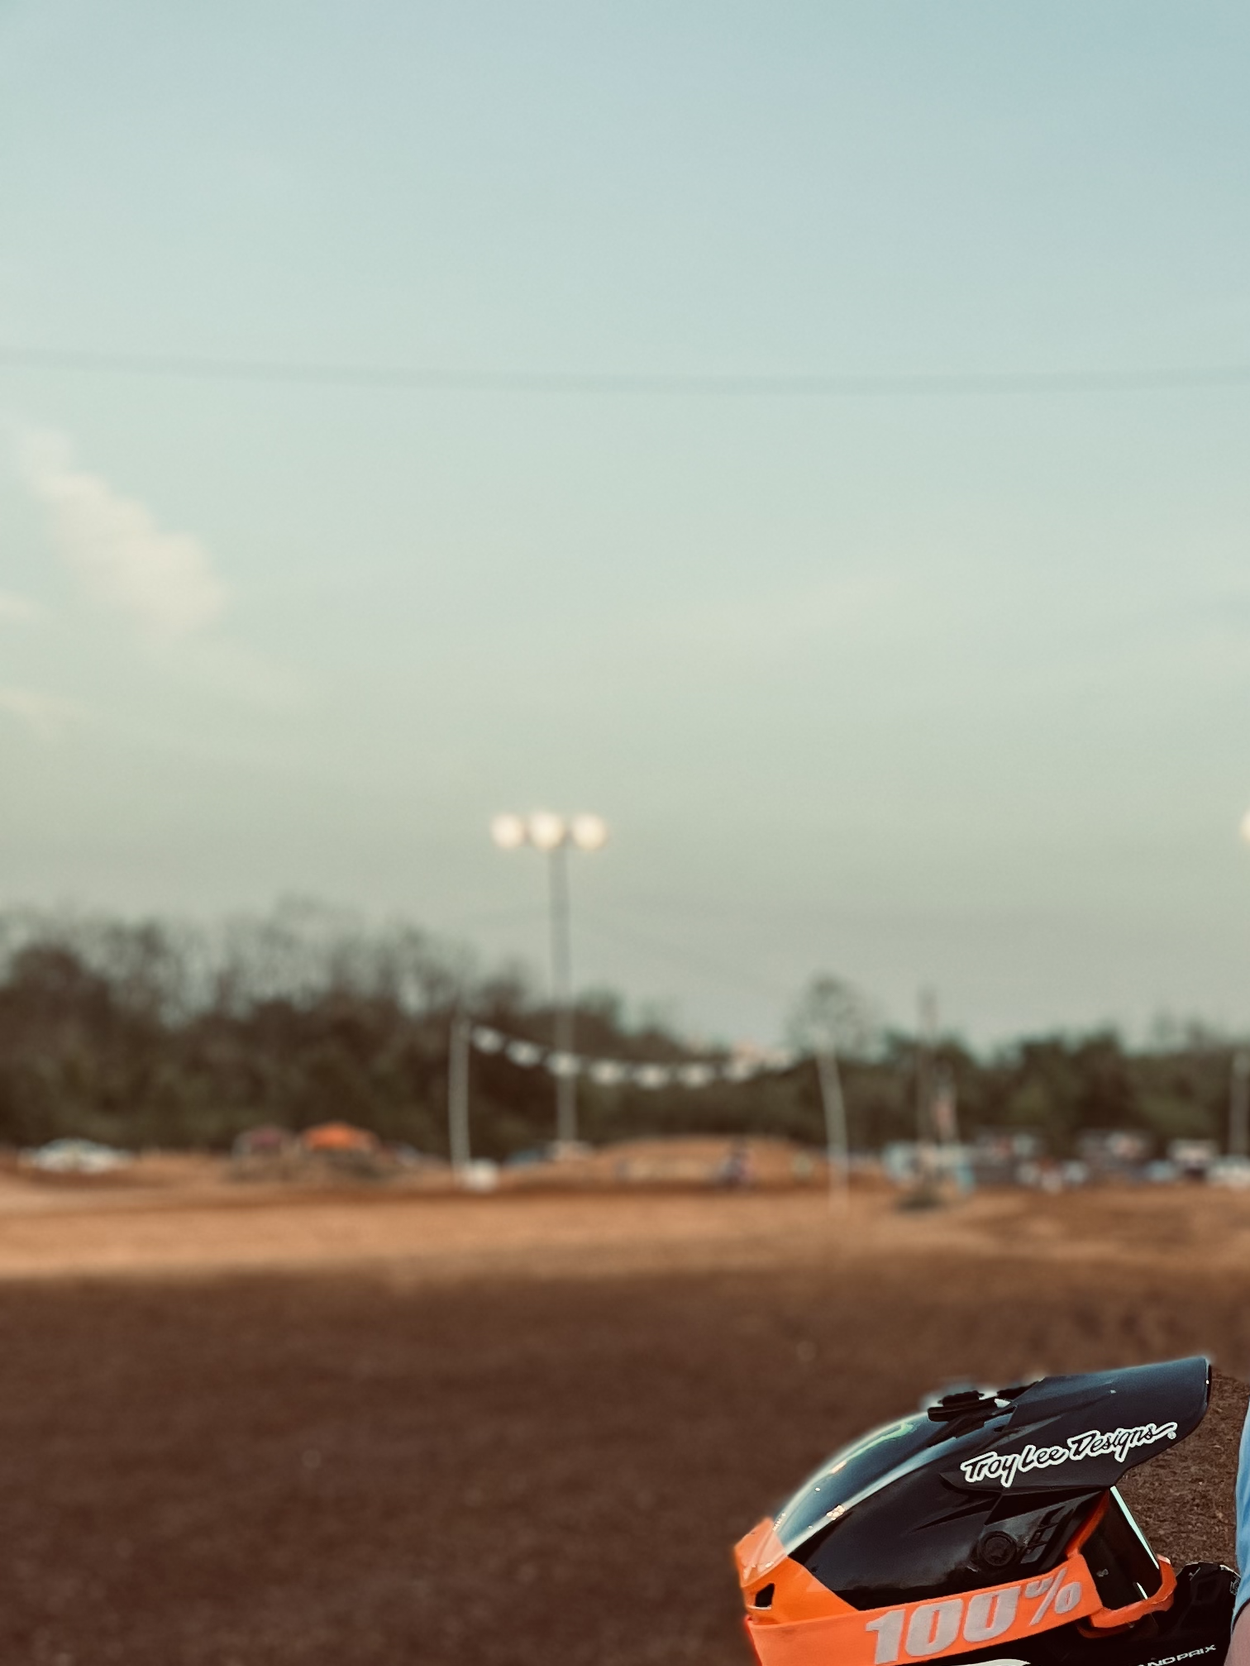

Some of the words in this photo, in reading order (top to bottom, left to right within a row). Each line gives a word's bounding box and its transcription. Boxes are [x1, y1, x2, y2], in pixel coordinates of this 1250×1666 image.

[960, 1452, 1020, 1488] Troy
[1018, 1444, 1069, 1472] Lee
[1067, 1422, 1178, 1462] Designs
[866, 1567, 1083, 1665] 100%
[1176, 1644, 1216, 1661] PRIX
